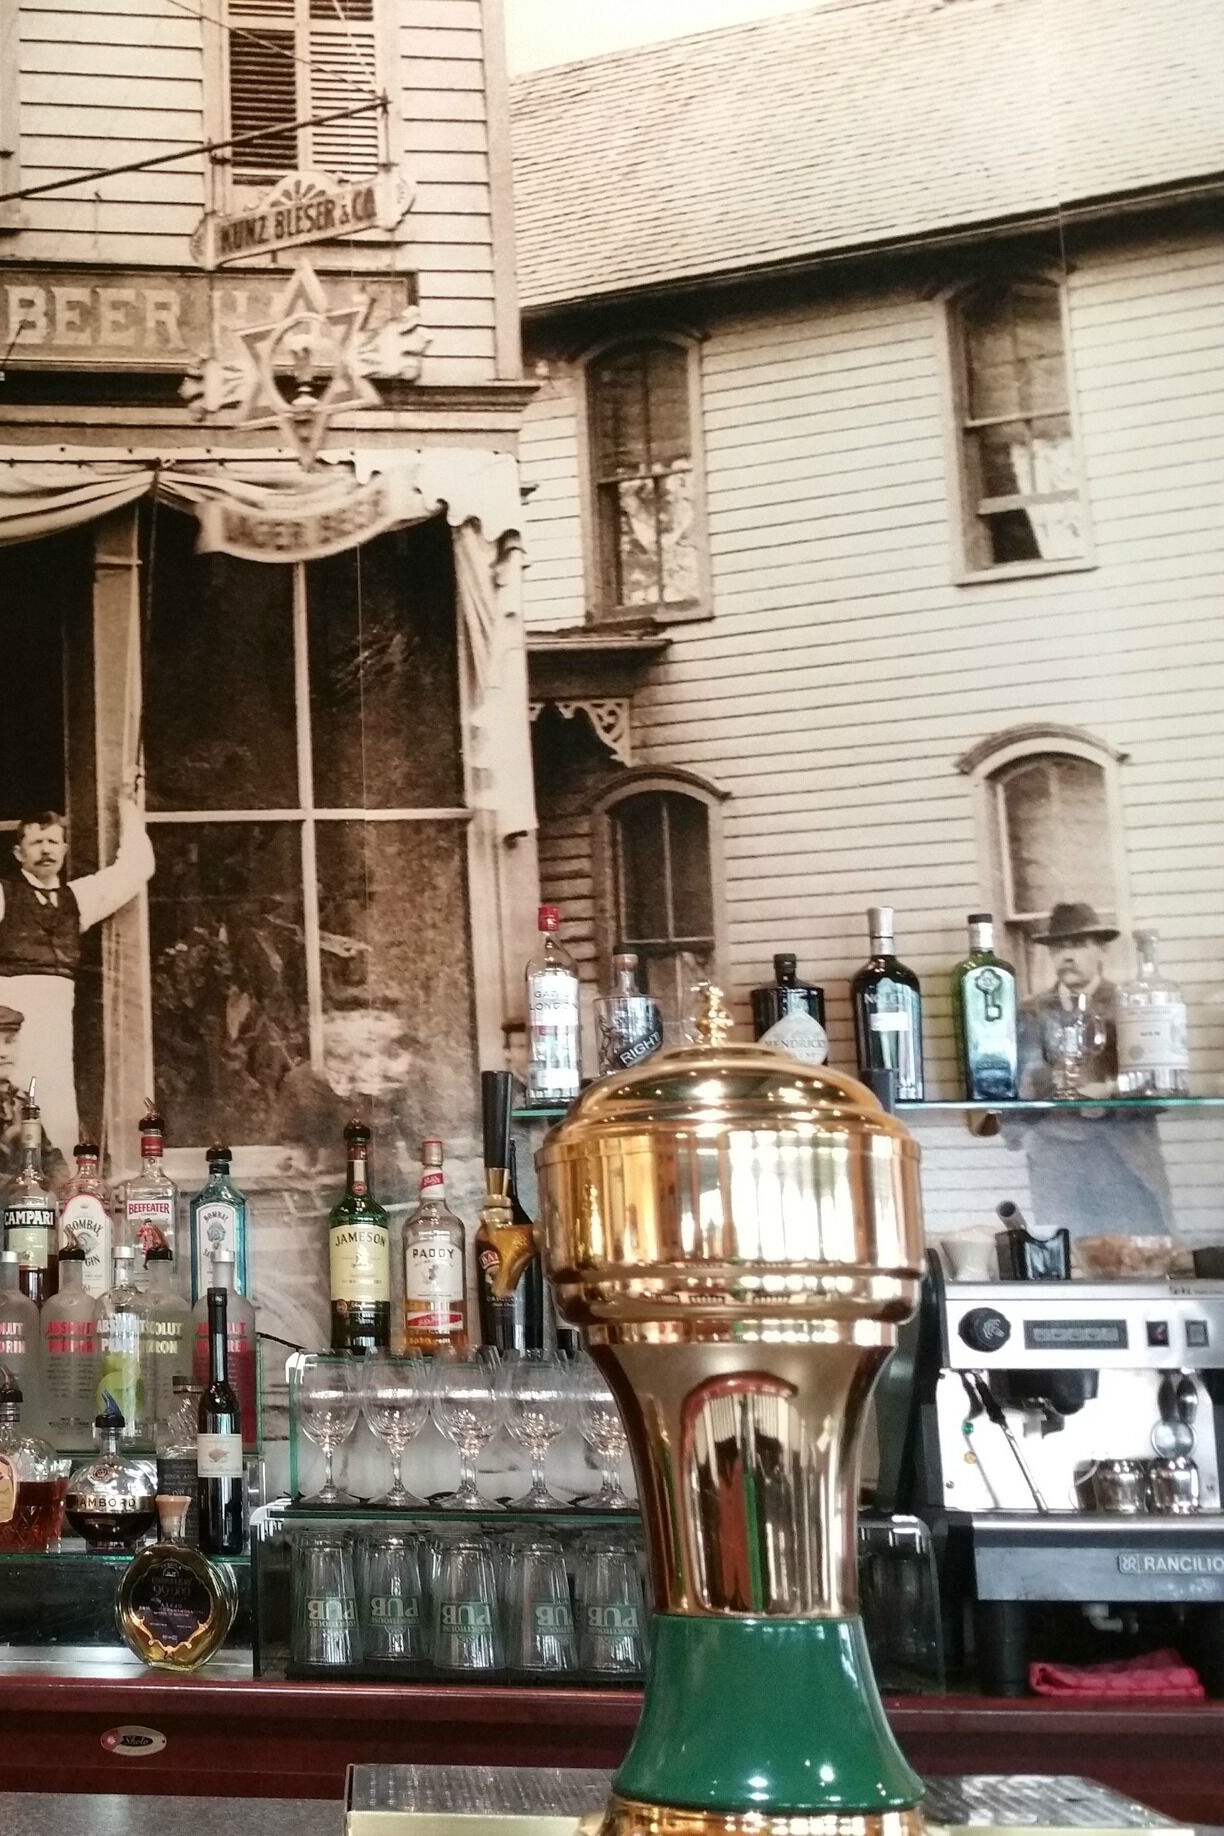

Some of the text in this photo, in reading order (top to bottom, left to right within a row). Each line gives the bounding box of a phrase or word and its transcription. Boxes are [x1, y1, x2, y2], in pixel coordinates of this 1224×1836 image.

[274, 198, 336, 240] BLESER
[2, 282, 188, 350] BEER
[619, 1031, 662, 1065] RIGHT
[128, 1202, 170, 1215] BEEFEATER
[4, 1211, 55, 1226] CAMPARI
[65, 1219, 104, 1238] BOMBAY
[335, 1231, 386, 1248] JAMESON
[84, 1256, 101, 1268] GIN
[412, 1248, 455, 1259] PADDY
[1143, 1555, 1224, 1572] RANCILIO
[308, 1600, 355, 1620] PUB
[370, 1597, 419, 1616] PUB
[442, 1605, 491, 1625] PUB
[587, 1607, 639, 1627] PUB
